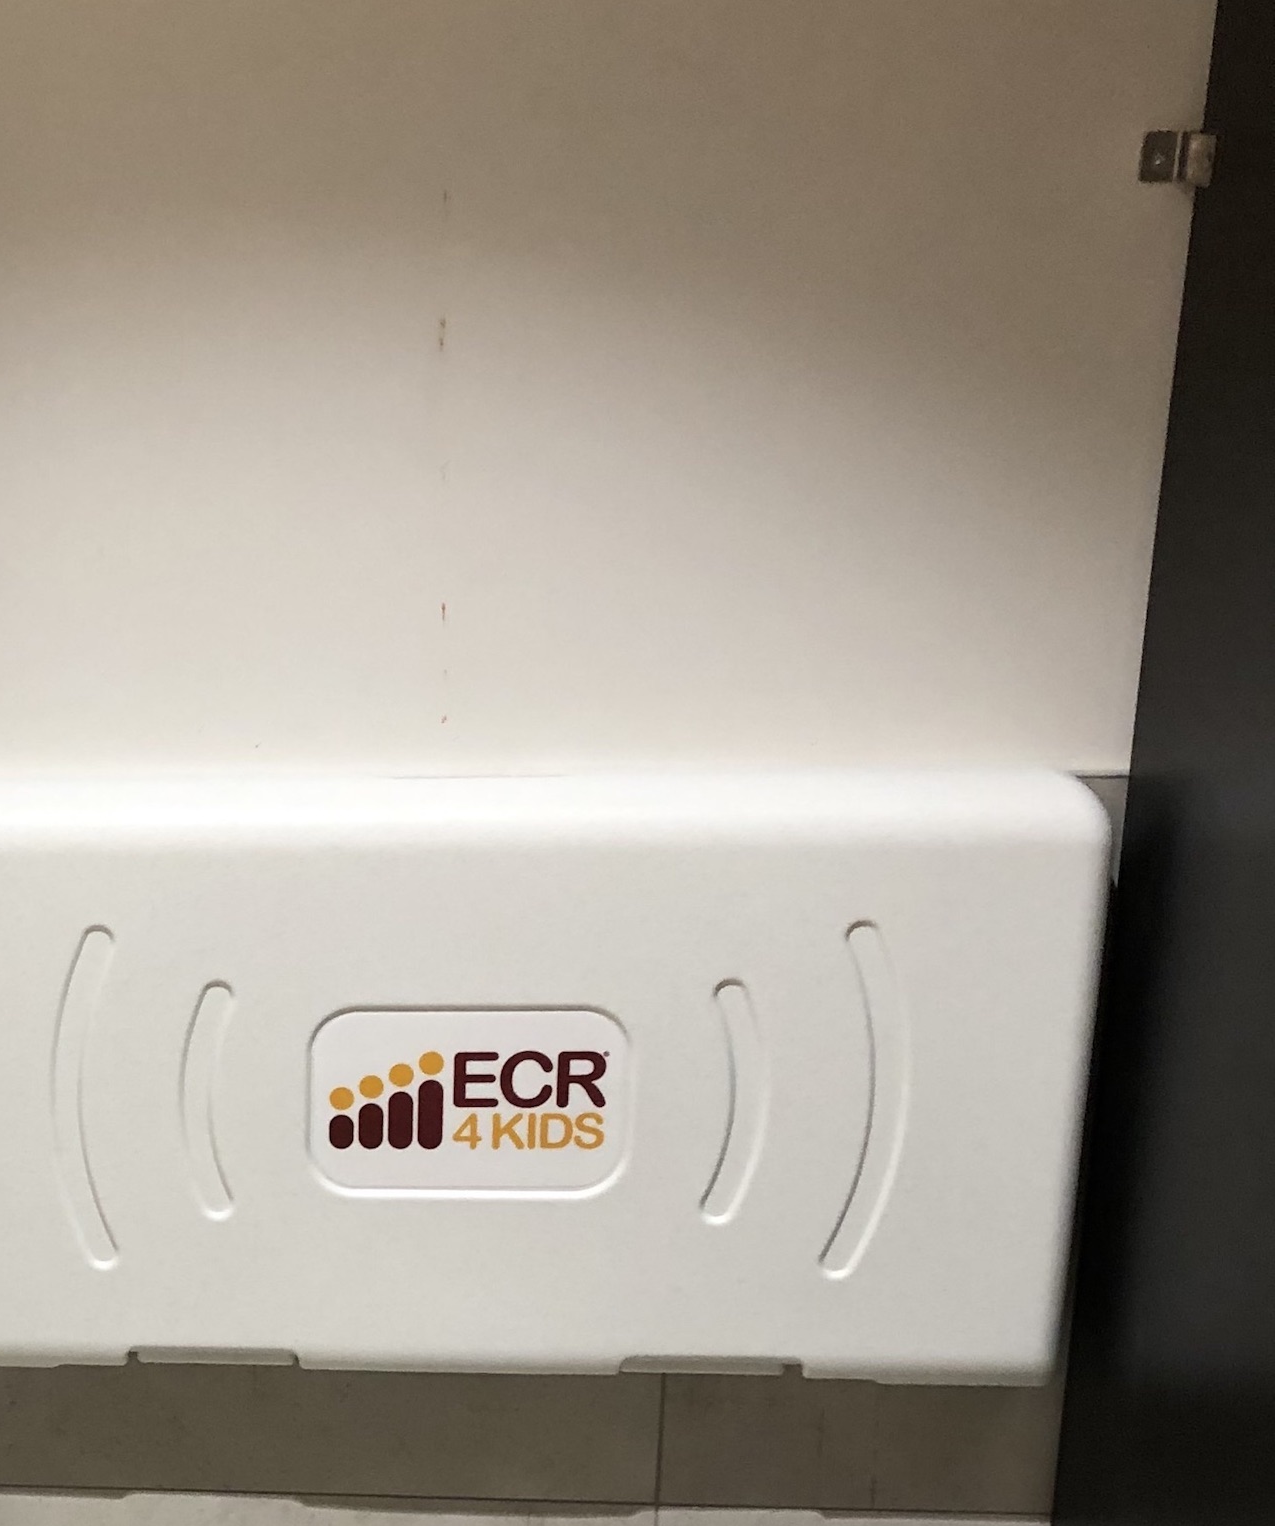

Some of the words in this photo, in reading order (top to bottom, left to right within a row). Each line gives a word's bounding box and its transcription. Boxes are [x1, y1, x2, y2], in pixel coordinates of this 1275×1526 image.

[452, 1050, 607, 1109] ECR
[452, 1112, 482, 1150] 4
[491, 1112, 605, 1150] KIDS
